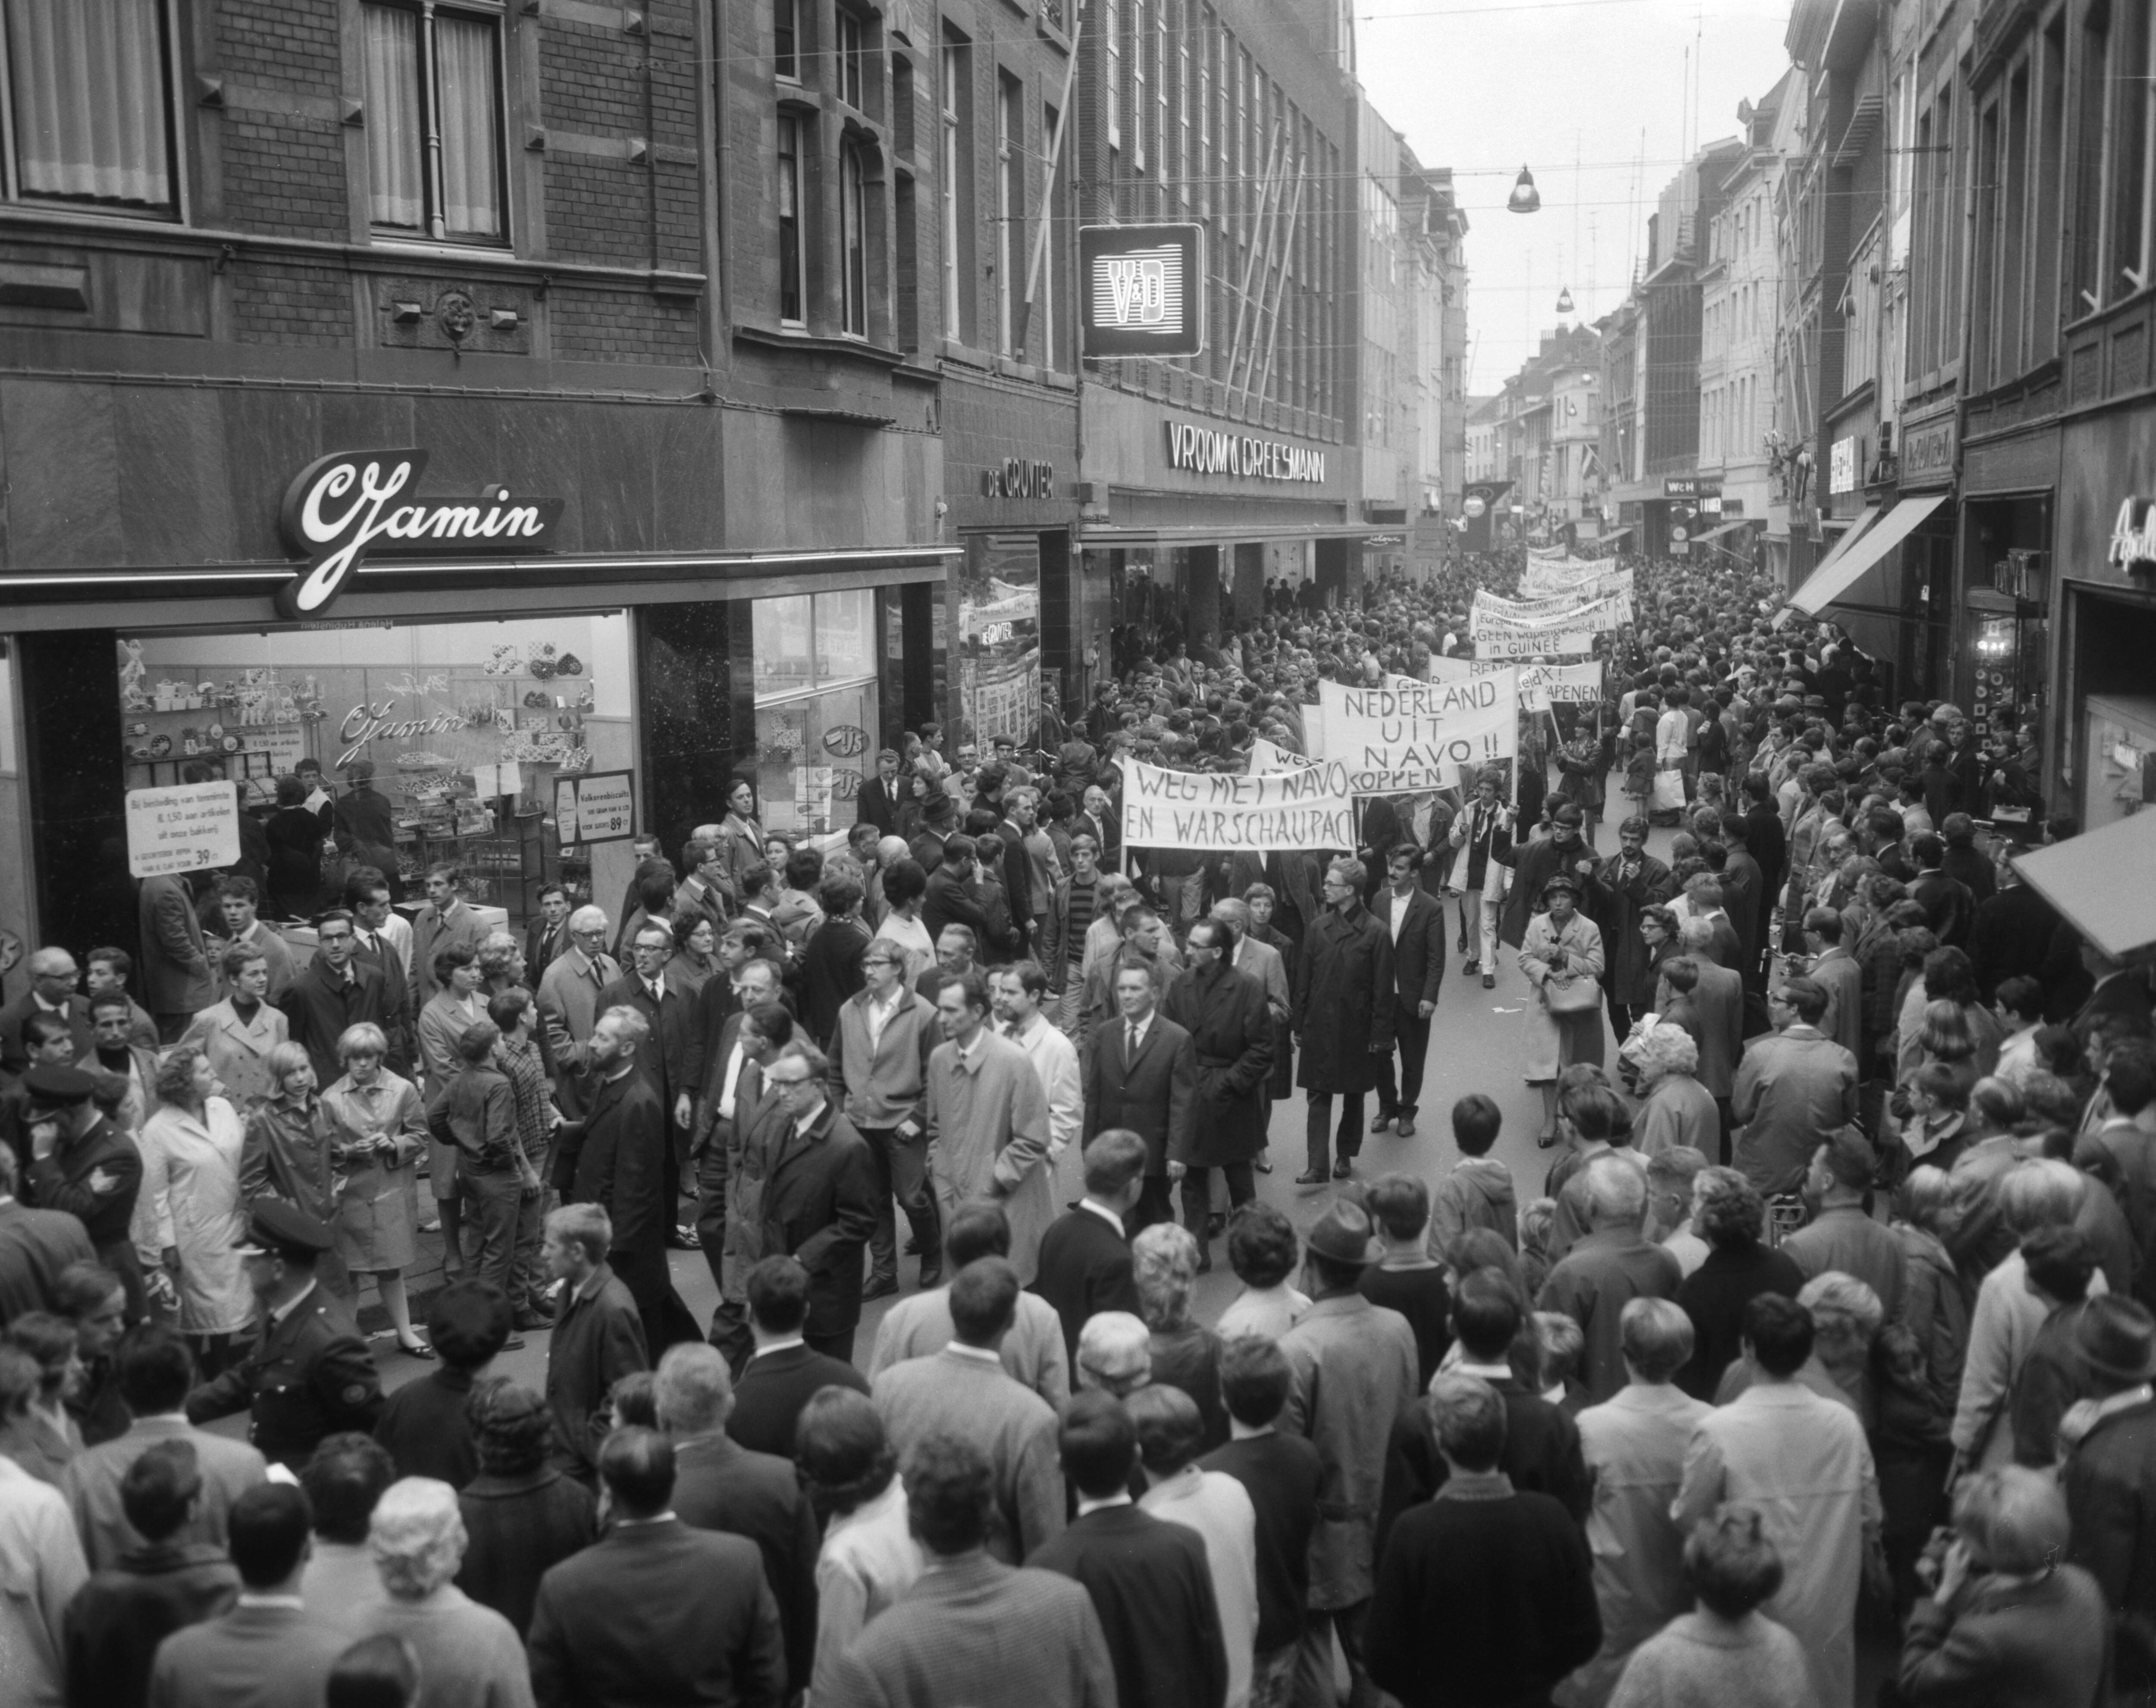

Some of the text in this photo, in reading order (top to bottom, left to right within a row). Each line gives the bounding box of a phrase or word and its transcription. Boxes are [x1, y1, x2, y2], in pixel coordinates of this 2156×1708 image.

[1108, 260, 1164, 323] V&D
[1170, 422, 1227, 473] VROOM
[1243, 437, 1324, 483] DREESMANN
[988, 457, 1053, 498] DE GRUYTER
[1480, 614, 1512, 628] Europa
[1477, 629, 1512, 642] GEEN
[1490, 644, 1500, 655] in
[1345, 681, 1495, 718] NEDERLAND
[1546, 685, 1600, 701] APENEN
[1365, 733, 1499, 768] NAVO !!
[1137, 765, 1198, 801] WEG
[1282, 762, 1348, 801] NAVO
[580, 790, 629, 802] Volkorenbiscuits
[200, 807, 231, 818] artikelen
[611, 817, 622, 830] 89
[1125, 804, 1354, 847] EN WARSCHAUPACT
[197, 849, 210, 865] 39
